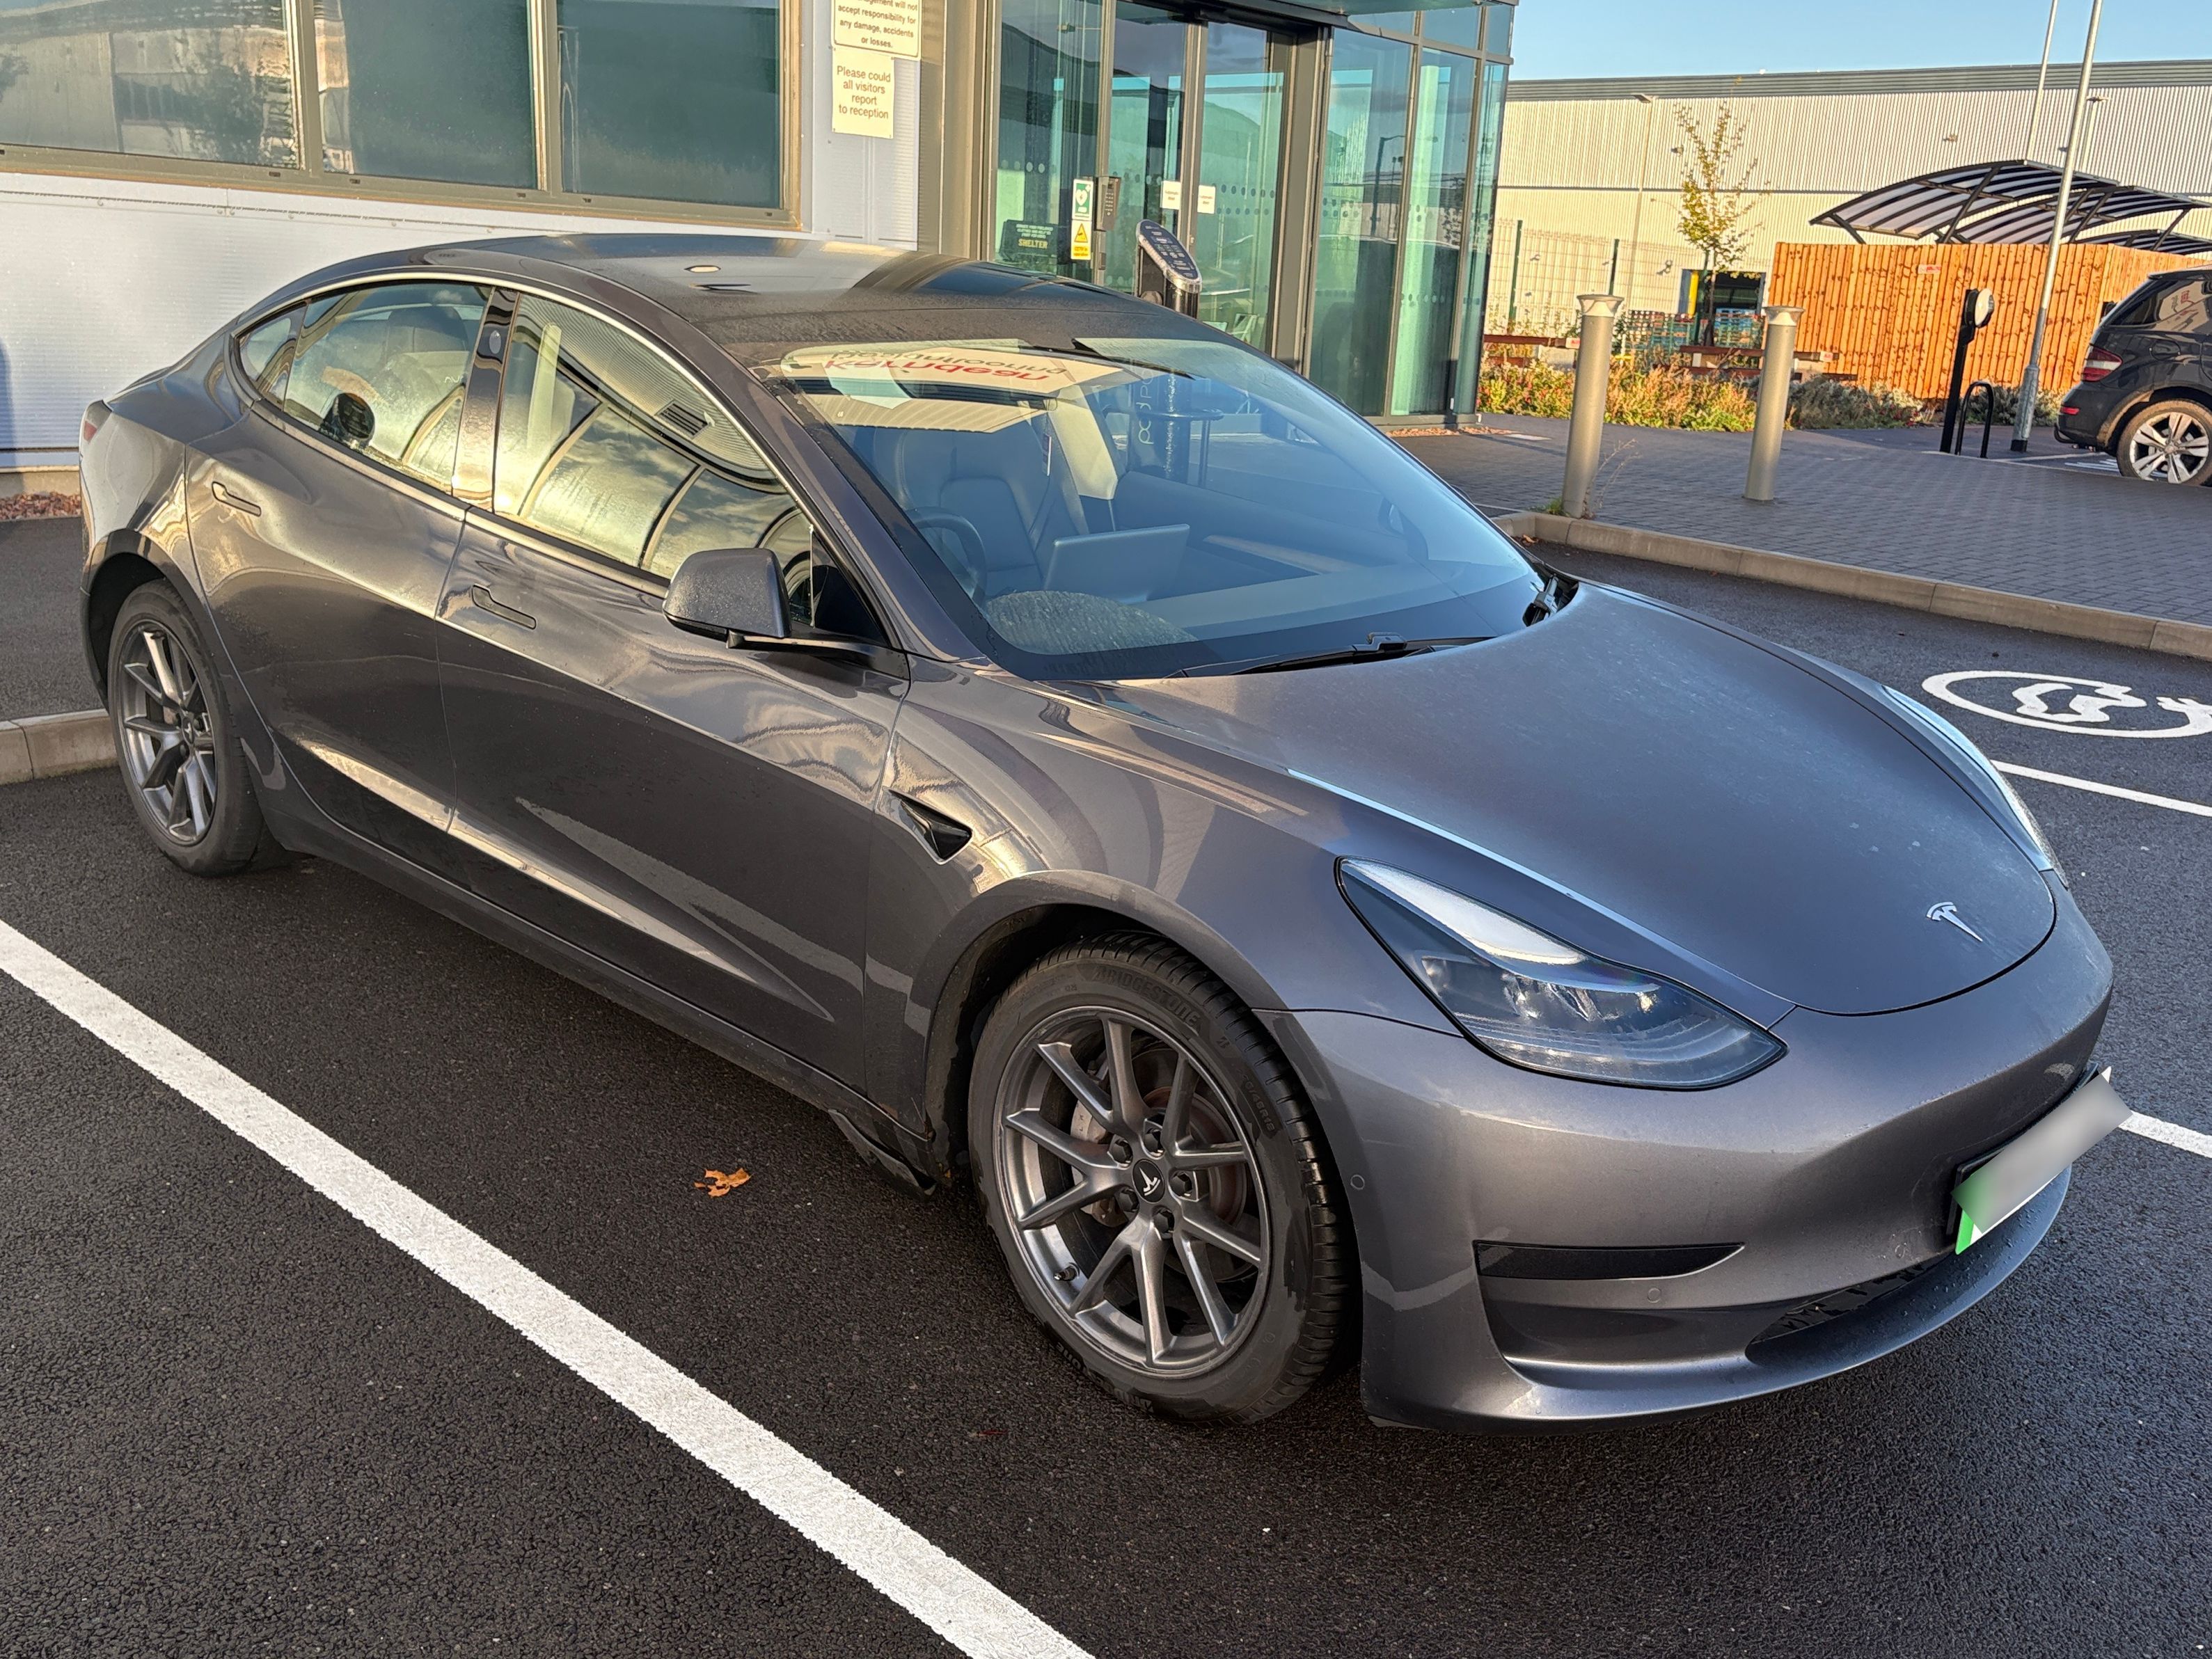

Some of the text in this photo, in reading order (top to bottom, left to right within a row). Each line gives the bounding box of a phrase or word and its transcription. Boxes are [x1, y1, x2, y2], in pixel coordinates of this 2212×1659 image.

[838, 4, 860, 15] accept
[862, 8, 906, 24] responsibility
[839, 19, 914, 38] any damage, accidents
[870, 36, 893, 48] losses.
[837, 65, 891, 83] Please could
[843, 80, 885, 94] all visitors
[851, 94, 877, 105] report
[839, 104, 889, 119] to reception
